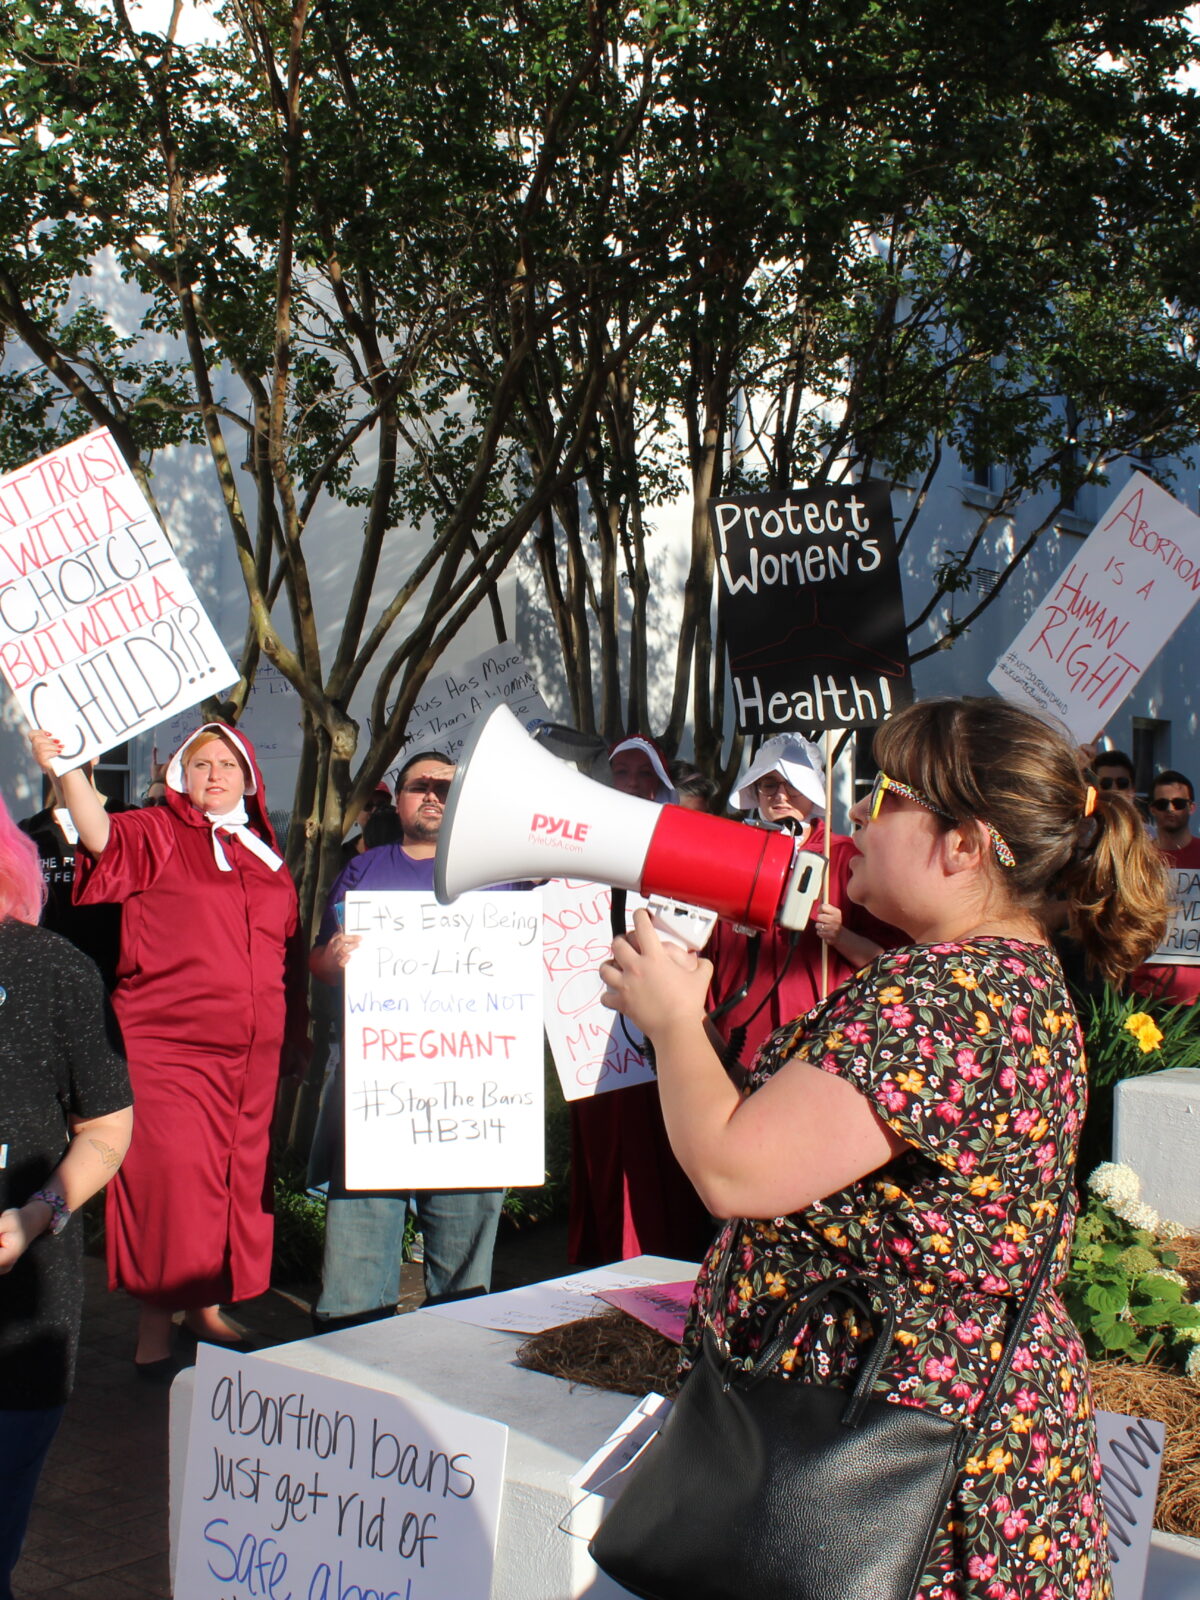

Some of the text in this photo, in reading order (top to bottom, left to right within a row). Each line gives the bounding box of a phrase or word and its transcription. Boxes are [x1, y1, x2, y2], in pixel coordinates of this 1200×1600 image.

[31, 432, 126, 506] TRUST
[0, 485, 135, 577] WITH A
[715, 494, 870, 554] Protect
[0, 519, 172, 634] CHOICE
[1103, 555, 1155, 601] IS A
[1, 575, 184, 689] BUT WITH A
[1054, 563, 1130, 649] HUMAN
[444, 676, 480, 701] Has
[481, 655, 524, 682] More
[1028, 605, 1141, 709] RIGHT
[427, 711, 467, 735] Than
[470, 696, 483, 714] A
[733, 674, 893, 728] Health!
[530, 812, 588, 843] PYLE
[347, 900, 538, 947] It's Easy Being
[377, 947, 495, 978] Pro-Life
[347, 992, 410, 1014] When
[487, 992, 535, 1013] NOT
[361, 1027, 517, 1061] PREGNANT
[565, 1023, 619, 1062] My
[211, 1370, 476, 1499] abortion bans
[271, 1472, 328, 1531] get
[337, 1492, 385, 1552] rid
[398, 1512, 438, 1568] of
